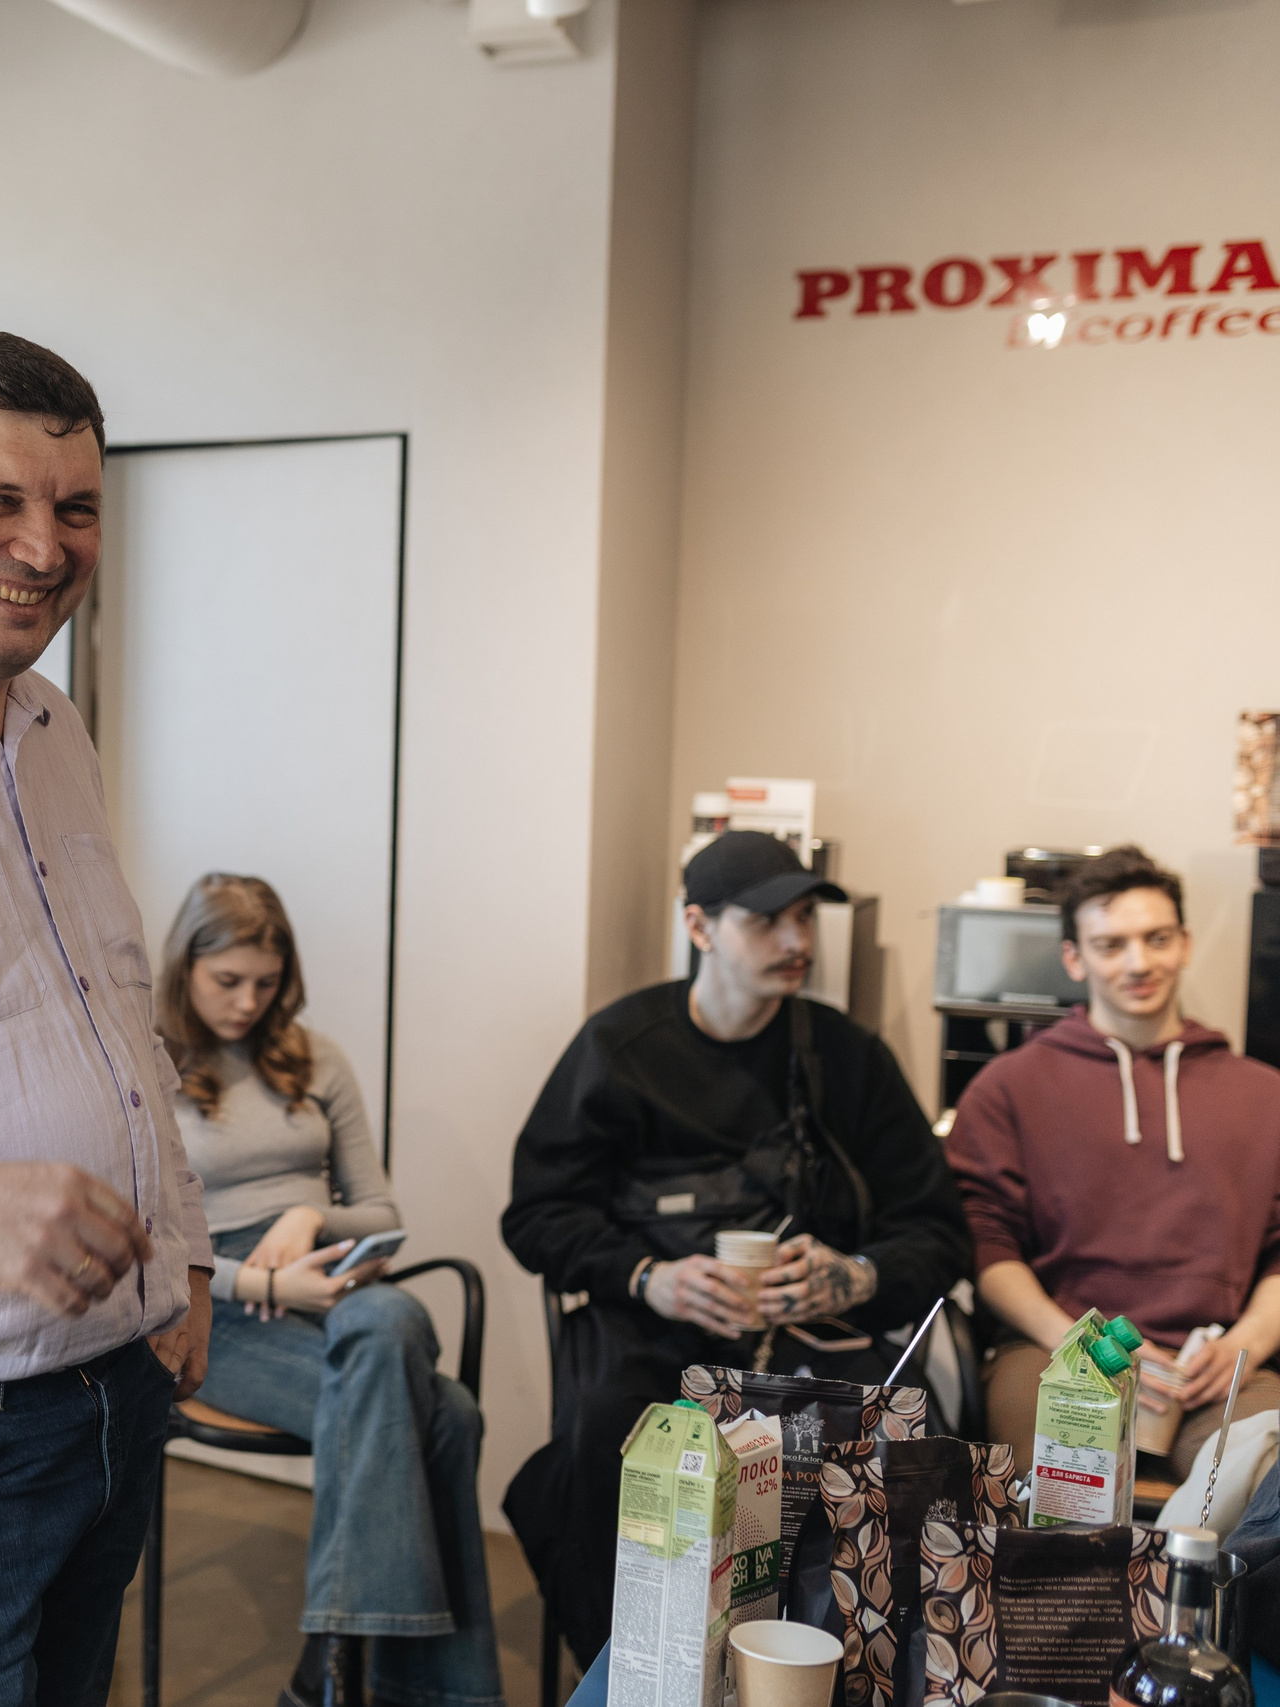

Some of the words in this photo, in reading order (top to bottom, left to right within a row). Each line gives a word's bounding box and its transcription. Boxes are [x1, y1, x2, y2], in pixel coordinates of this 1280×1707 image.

[793, 237, 1280, 320] PROXIMA
[1060, 1391, 1075, 1399] Кокос
[1049, 1406, 1070, 1414] Нежная
[1087, 1413, 1107, 1421] уносит
[1059, 1414, 1096, 1424] воображение
[1055, 1419, 1090, 1429] тропический
[738, 1456, 778, 1485] ЛОКО
[1051, 1470, 1064, 1478] ДЛЯ
[1064, 1472, 1091, 1483] БАРИСТА
[756, 1478, 778, 1496] 3,2%
[732, 1555, 748, 1573] KO
[732, 1590, 761, 1607] ESSIONAL
[1037, 1615, 1086, 1623] наслаждаться
